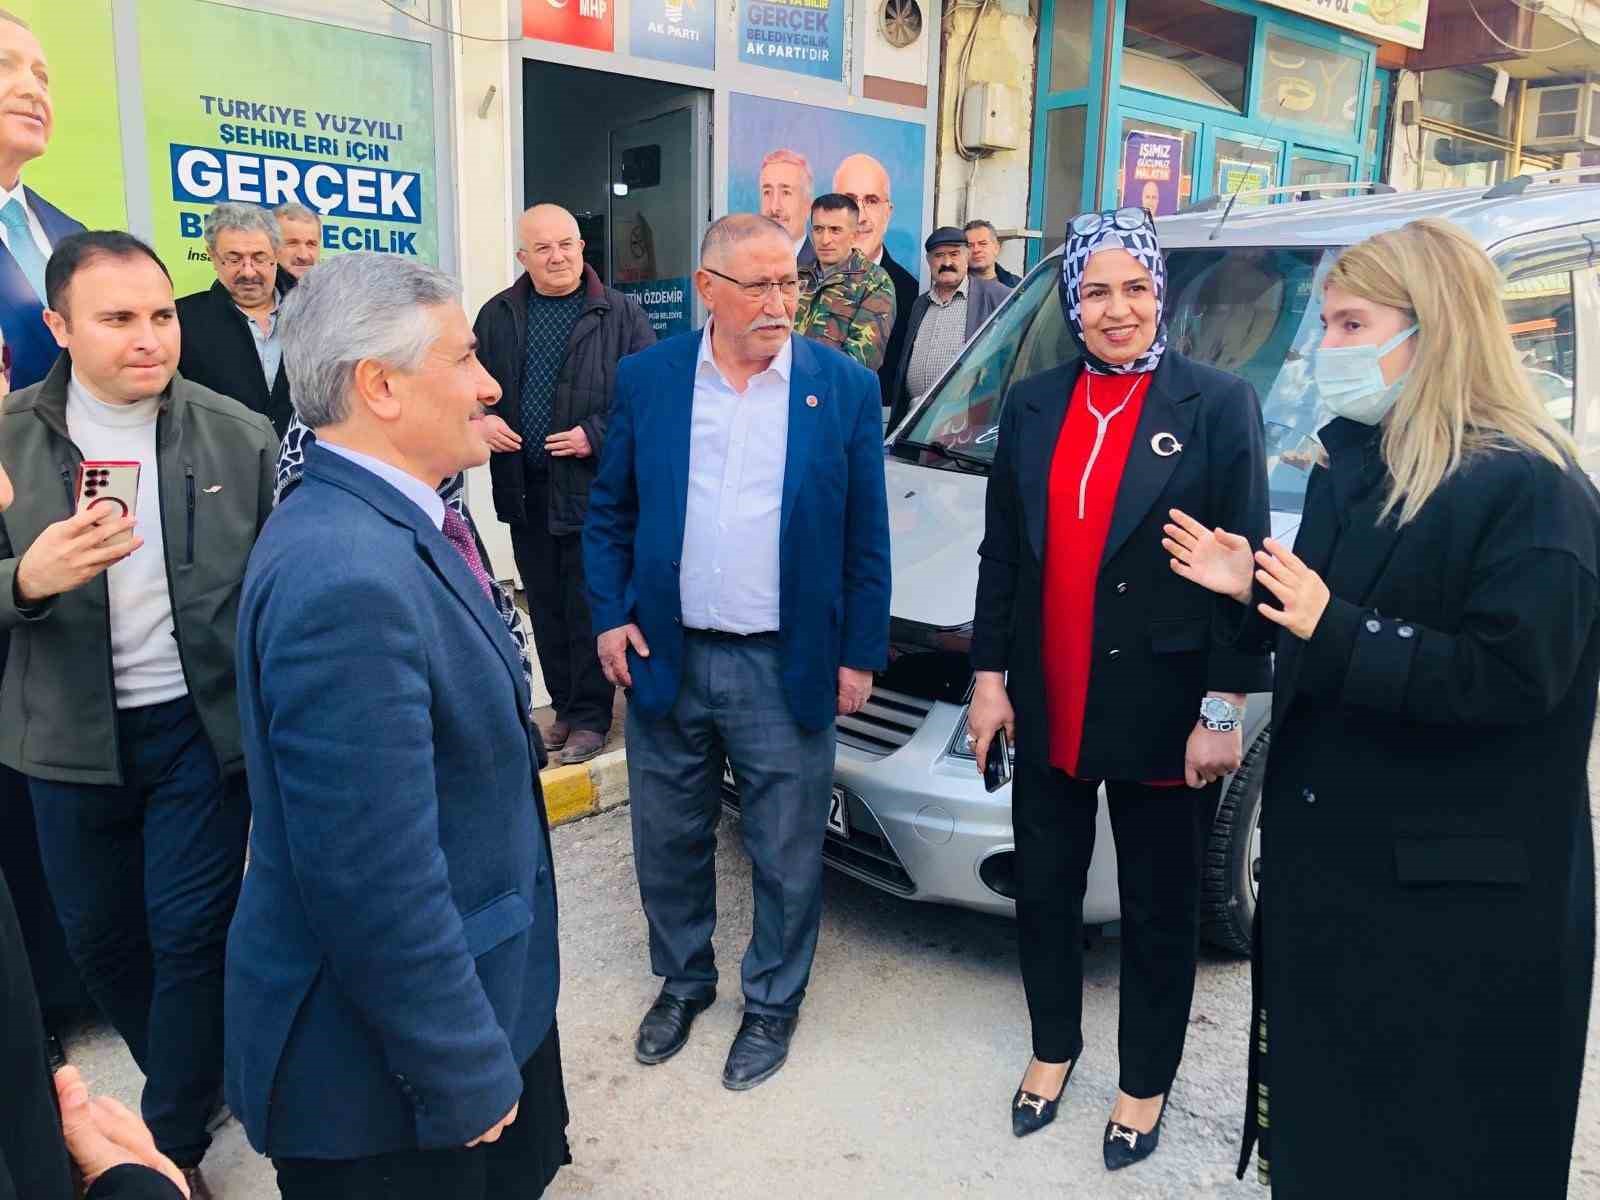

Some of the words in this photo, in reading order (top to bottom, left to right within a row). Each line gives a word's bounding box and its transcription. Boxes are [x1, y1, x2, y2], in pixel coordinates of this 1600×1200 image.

[647, 21, 664, 34] AK
[747, 4, 829, 32] GERÇEK
[747, 42, 765, 56] AK
[200, 95, 307, 128] TÜRKİYE
[315, 112, 403, 141] YÜZYILI
[219, 123, 339, 156] ŞEHİRLERİ
[346, 141, 390, 163] İÇİN
[178, 149, 417, 217] GERÇEK
[643, 287, 683, 304] ÖZDEMİR
